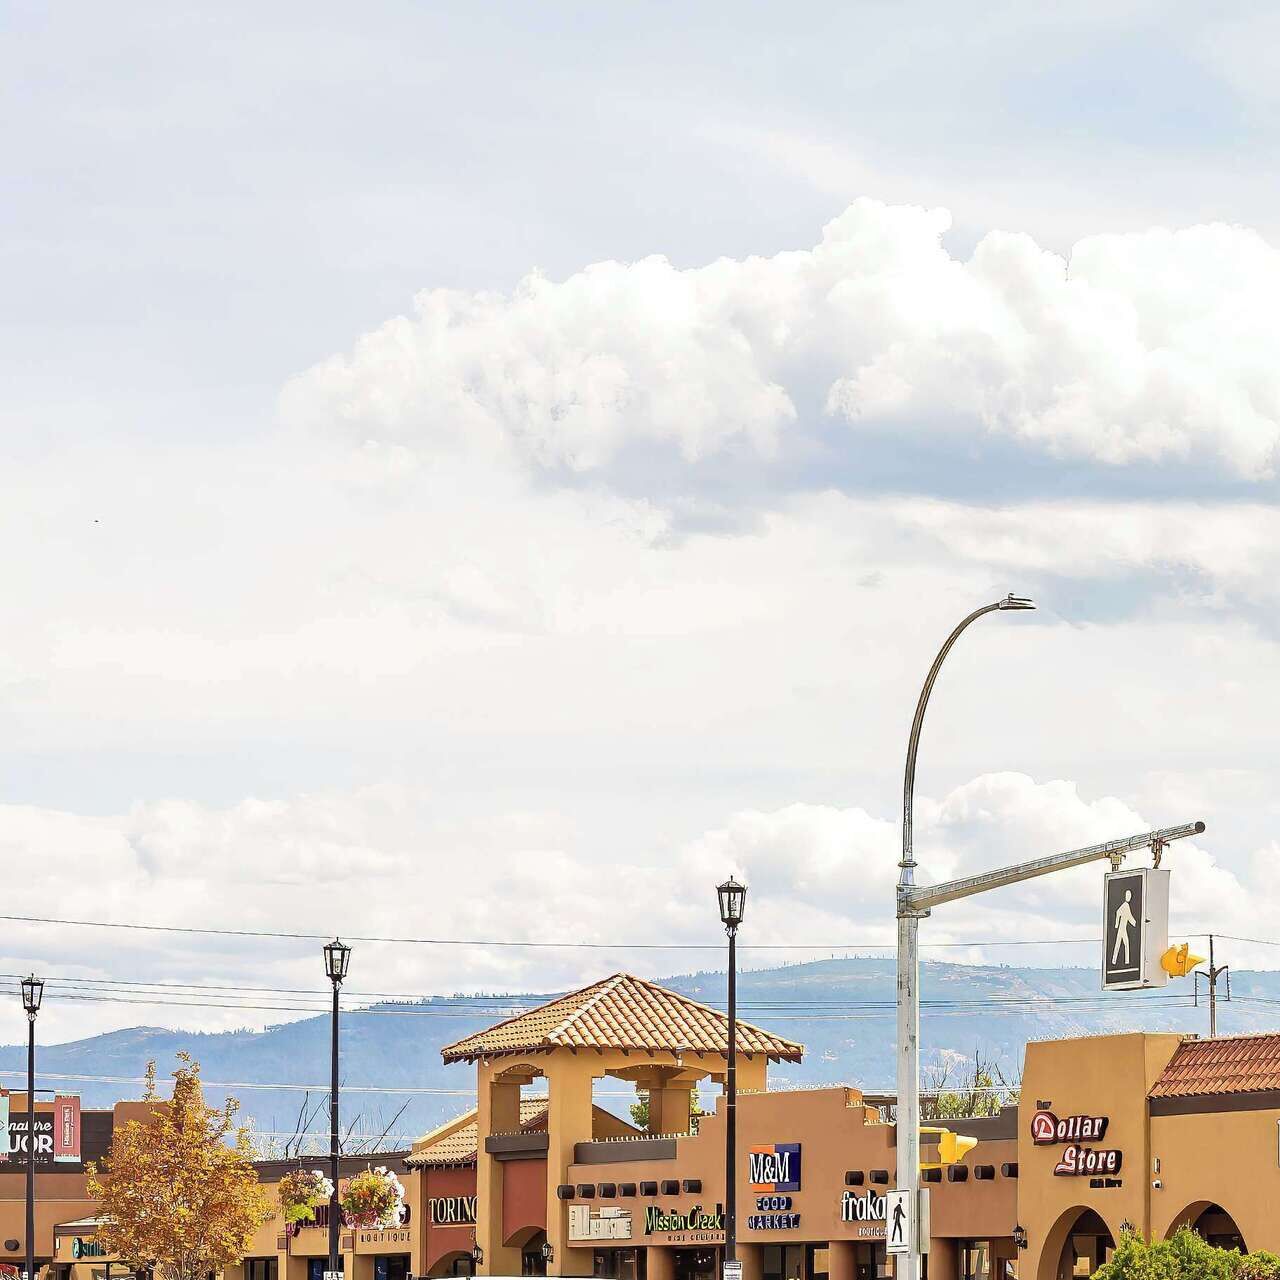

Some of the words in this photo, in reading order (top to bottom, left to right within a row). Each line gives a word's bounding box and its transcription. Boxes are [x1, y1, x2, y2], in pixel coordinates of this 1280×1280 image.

[1032, 1112, 1105, 1143] Dollar
[9, 1134, 54, 1154] UOR
[749, 1152, 790, 1183] M&M
[1055, 1146, 1119, 1174] Store
[645, 1205, 685, 1234] Mission
[688, 1204, 726, 1231] Creek
[841, 1190, 887, 1221] fraka
